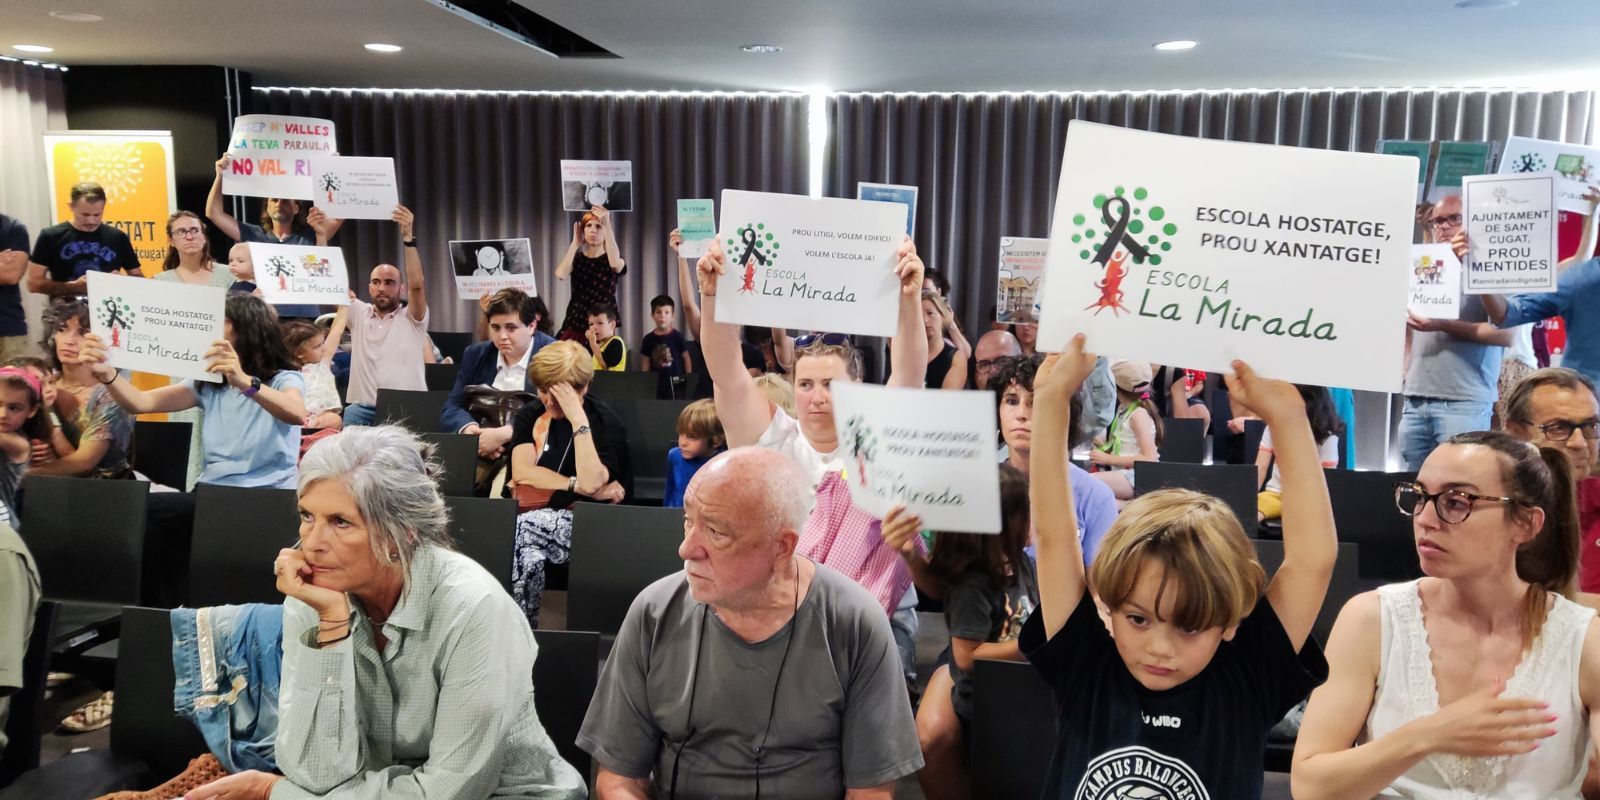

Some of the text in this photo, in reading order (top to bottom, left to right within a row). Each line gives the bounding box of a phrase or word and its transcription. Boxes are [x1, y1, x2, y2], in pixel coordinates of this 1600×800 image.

[285, 123, 329, 136] VALLES
[234, 139, 330, 151] LA TEVA PARAULA
[232, 158, 254, 176] NO
[257, 159, 287, 176] VAL
[1471, 210, 1550, 222] AJUNTAMENT
[1196, 206, 1392, 242] ESCOLA HOSTATGE,
[1485, 222, 1535, 233] DE SANT
[792, 228, 813, 237] PROU
[813, 230, 836, 240] LITIGI,
[837, 232, 863, 241] VOLEM
[1489, 234, 1531, 245] CUGAT,
[805, 250, 830, 258] VOLEM
[831, 251, 863, 261] L'ESCOLA
[1200, 233, 1382, 265] PROU XANTATGE!
[1488, 247, 1531, 259] PROU
[1471, 260, 1549, 272] MENTIDES
[765, 269, 806, 280] ESCOLA
[308, 283, 345, 293] Mirada
[1146, 269, 1231, 295] ESCOLA
[762, 279, 856, 303] La Mirada
[1412, 293, 1452, 305] Mirada
[141, 305, 216, 322] ESCOLA HOSTATGE,
[1139, 288, 1338, 342] La Mirada
[144, 317, 213, 332] PROU XANTATGE!
[126, 341, 199, 362] La Mirada
[891, 482, 965, 506] Mirada
[1085, 758, 1131, 800] CAMPUS
